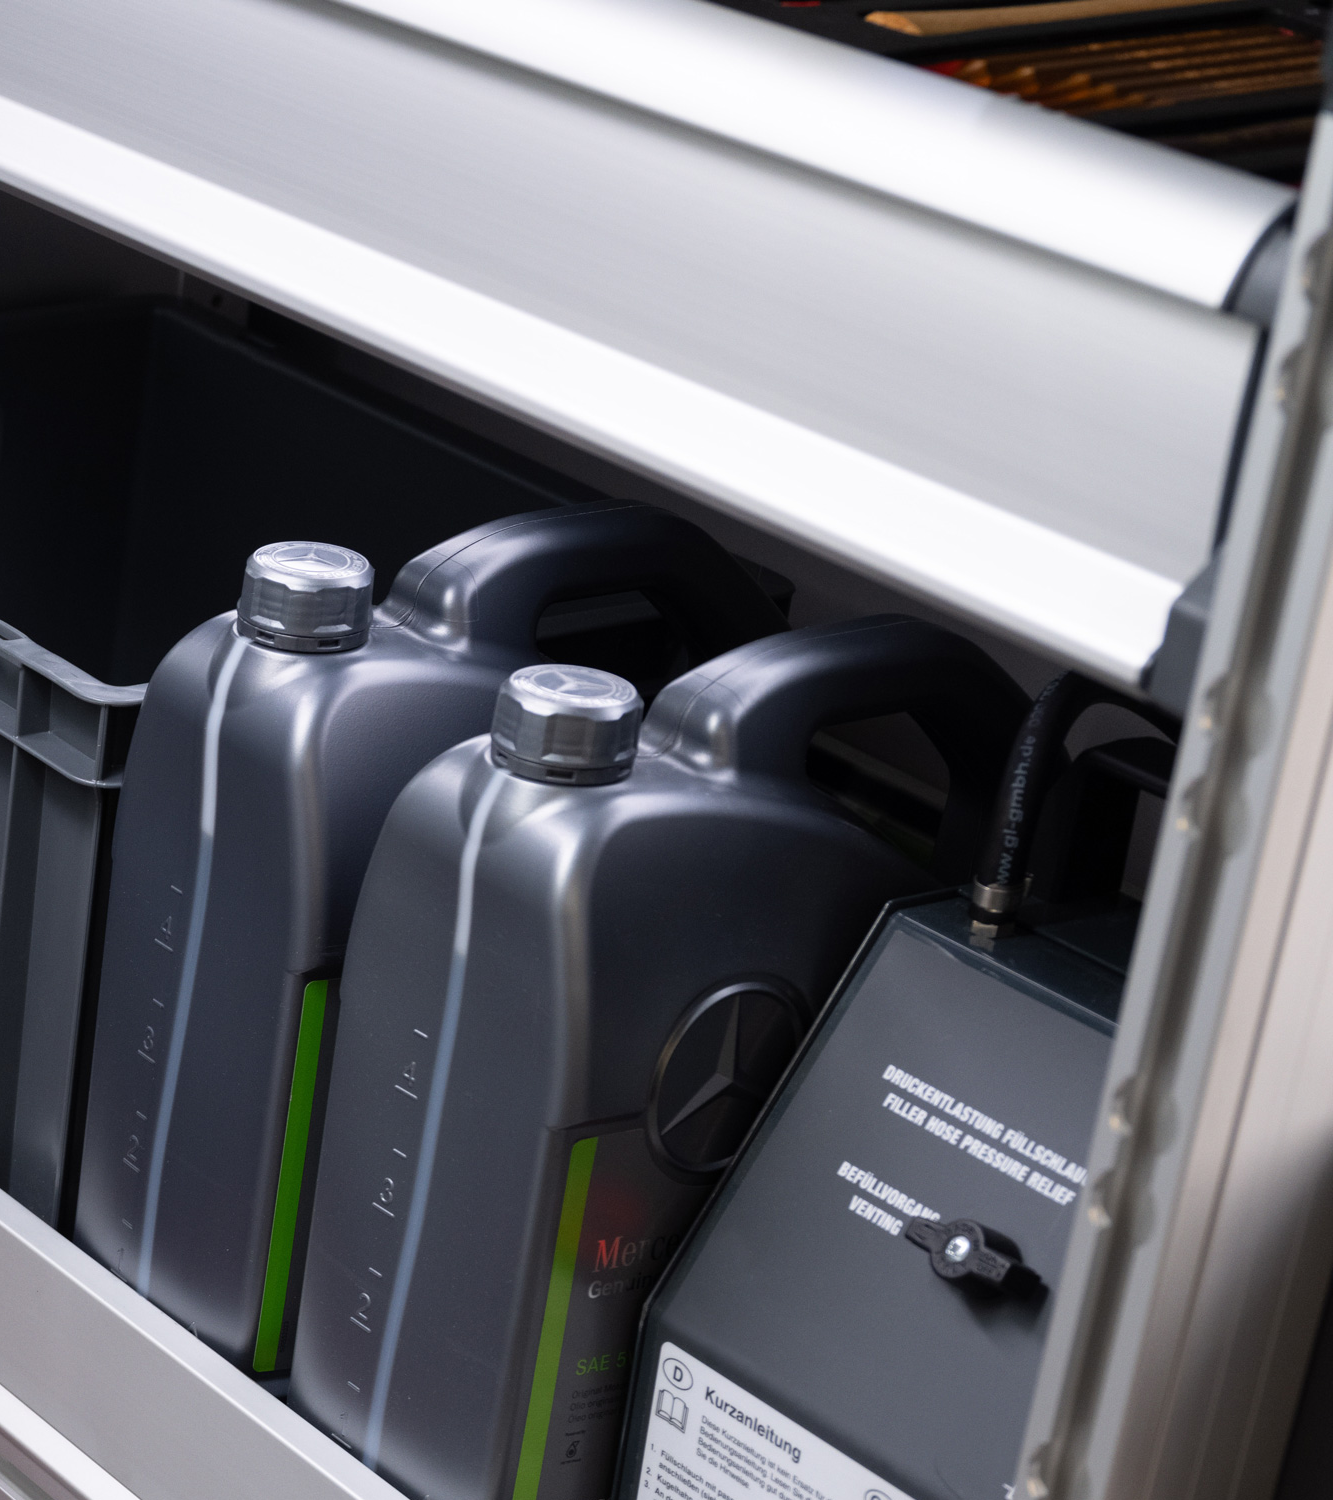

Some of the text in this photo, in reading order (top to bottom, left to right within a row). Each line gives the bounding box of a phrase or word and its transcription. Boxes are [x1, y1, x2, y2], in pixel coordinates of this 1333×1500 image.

[882, 1065, 1088, 1187] DRUCKENTLASTUNG FÜLLSCHLAU
[882, 1093, 1076, 1207] FILLER HOSE PRESSURE RELIEF
[848, 1195, 903, 1236] VENTING
[575, 1354, 611, 1376] SAE
[672, 1365, 683, 1382] D
[704, 1386, 801, 1464] Kurzanleitung
